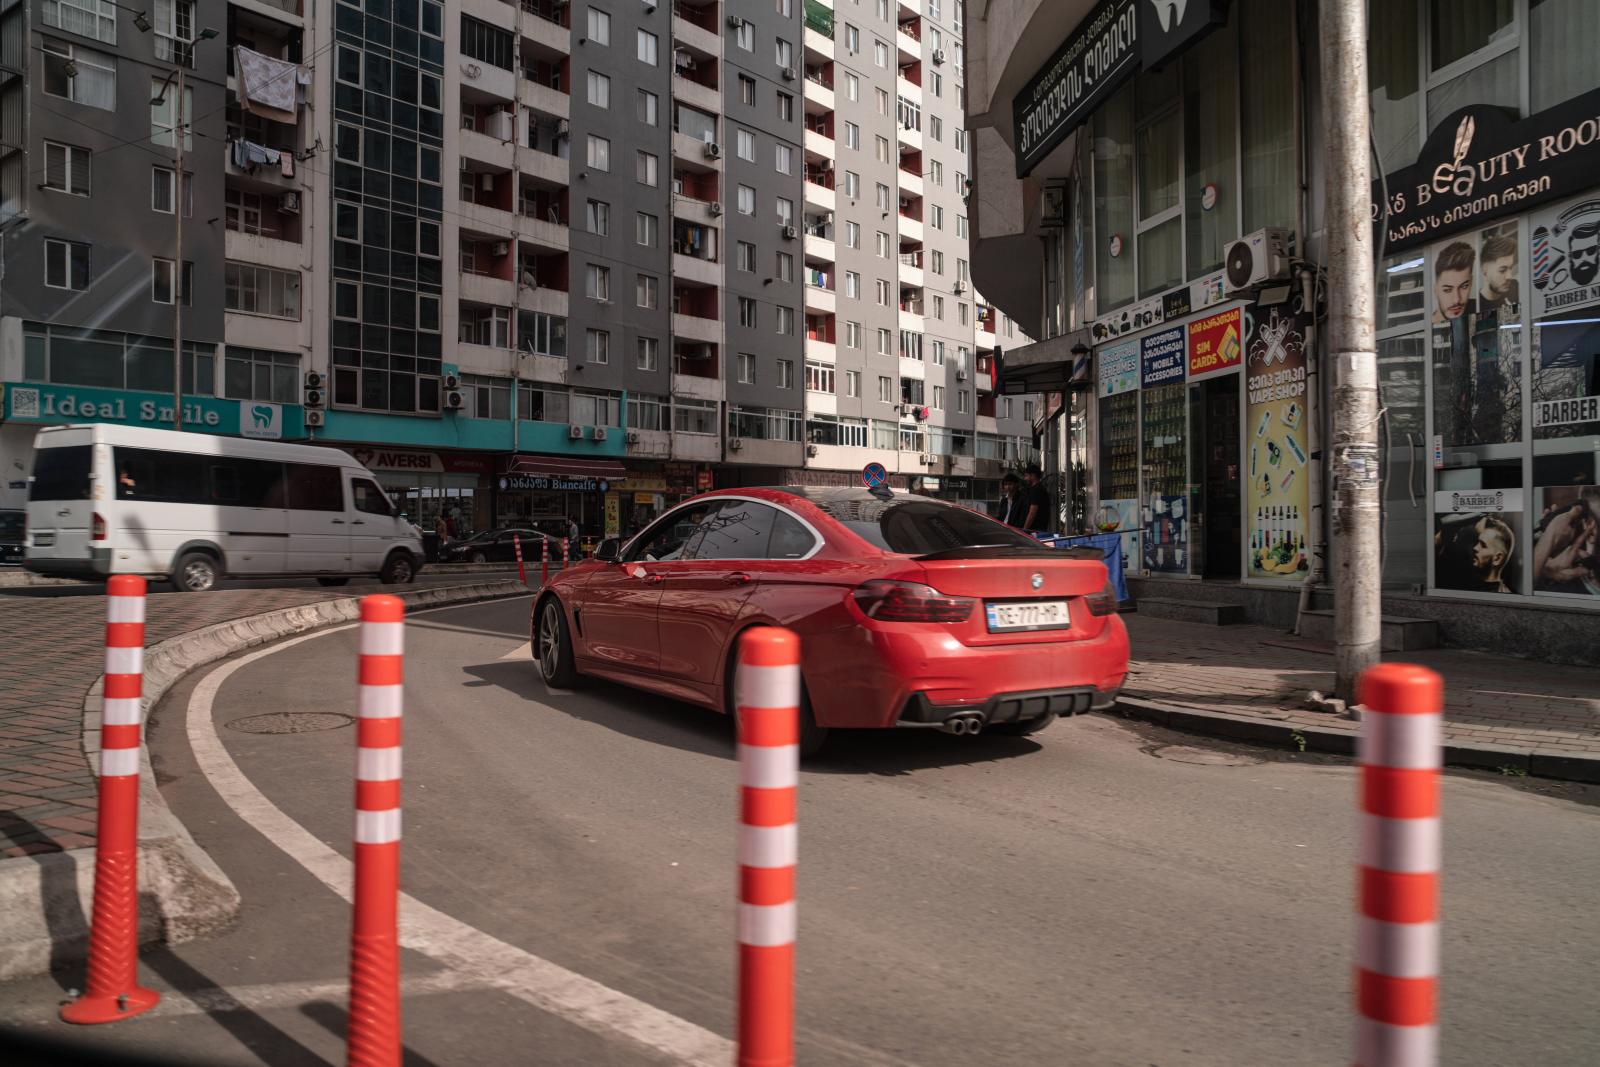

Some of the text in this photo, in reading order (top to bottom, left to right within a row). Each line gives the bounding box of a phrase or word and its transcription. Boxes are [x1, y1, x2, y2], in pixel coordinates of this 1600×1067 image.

[1021, 4, 1136, 152] ჰოლივუდის ღიმილი
[1538, 115, 1600, 161] ROO
[1443, 193, 1499, 224] ბიუთი
[1502, 175, 1550, 206] რუმი
[1545, 288, 1587, 309] BARBER
[1196, 341, 1211, 354] SIM
[1152, 357, 1174, 370] MOBILE
[1191, 353, 1217, 370] CARDS
[1144, 366, 1183, 383] ACCESSORIES
[1249, 382, 1305, 405] VAPE SHOP
[43, 393, 220, 426] Ideal Smile
[1542, 398, 1598, 424] BARBER
[377, 453, 431, 468] AVERSI
[552, 479, 597, 490] Biancaffe
[1459, 496, 1496, 506] BARBER
